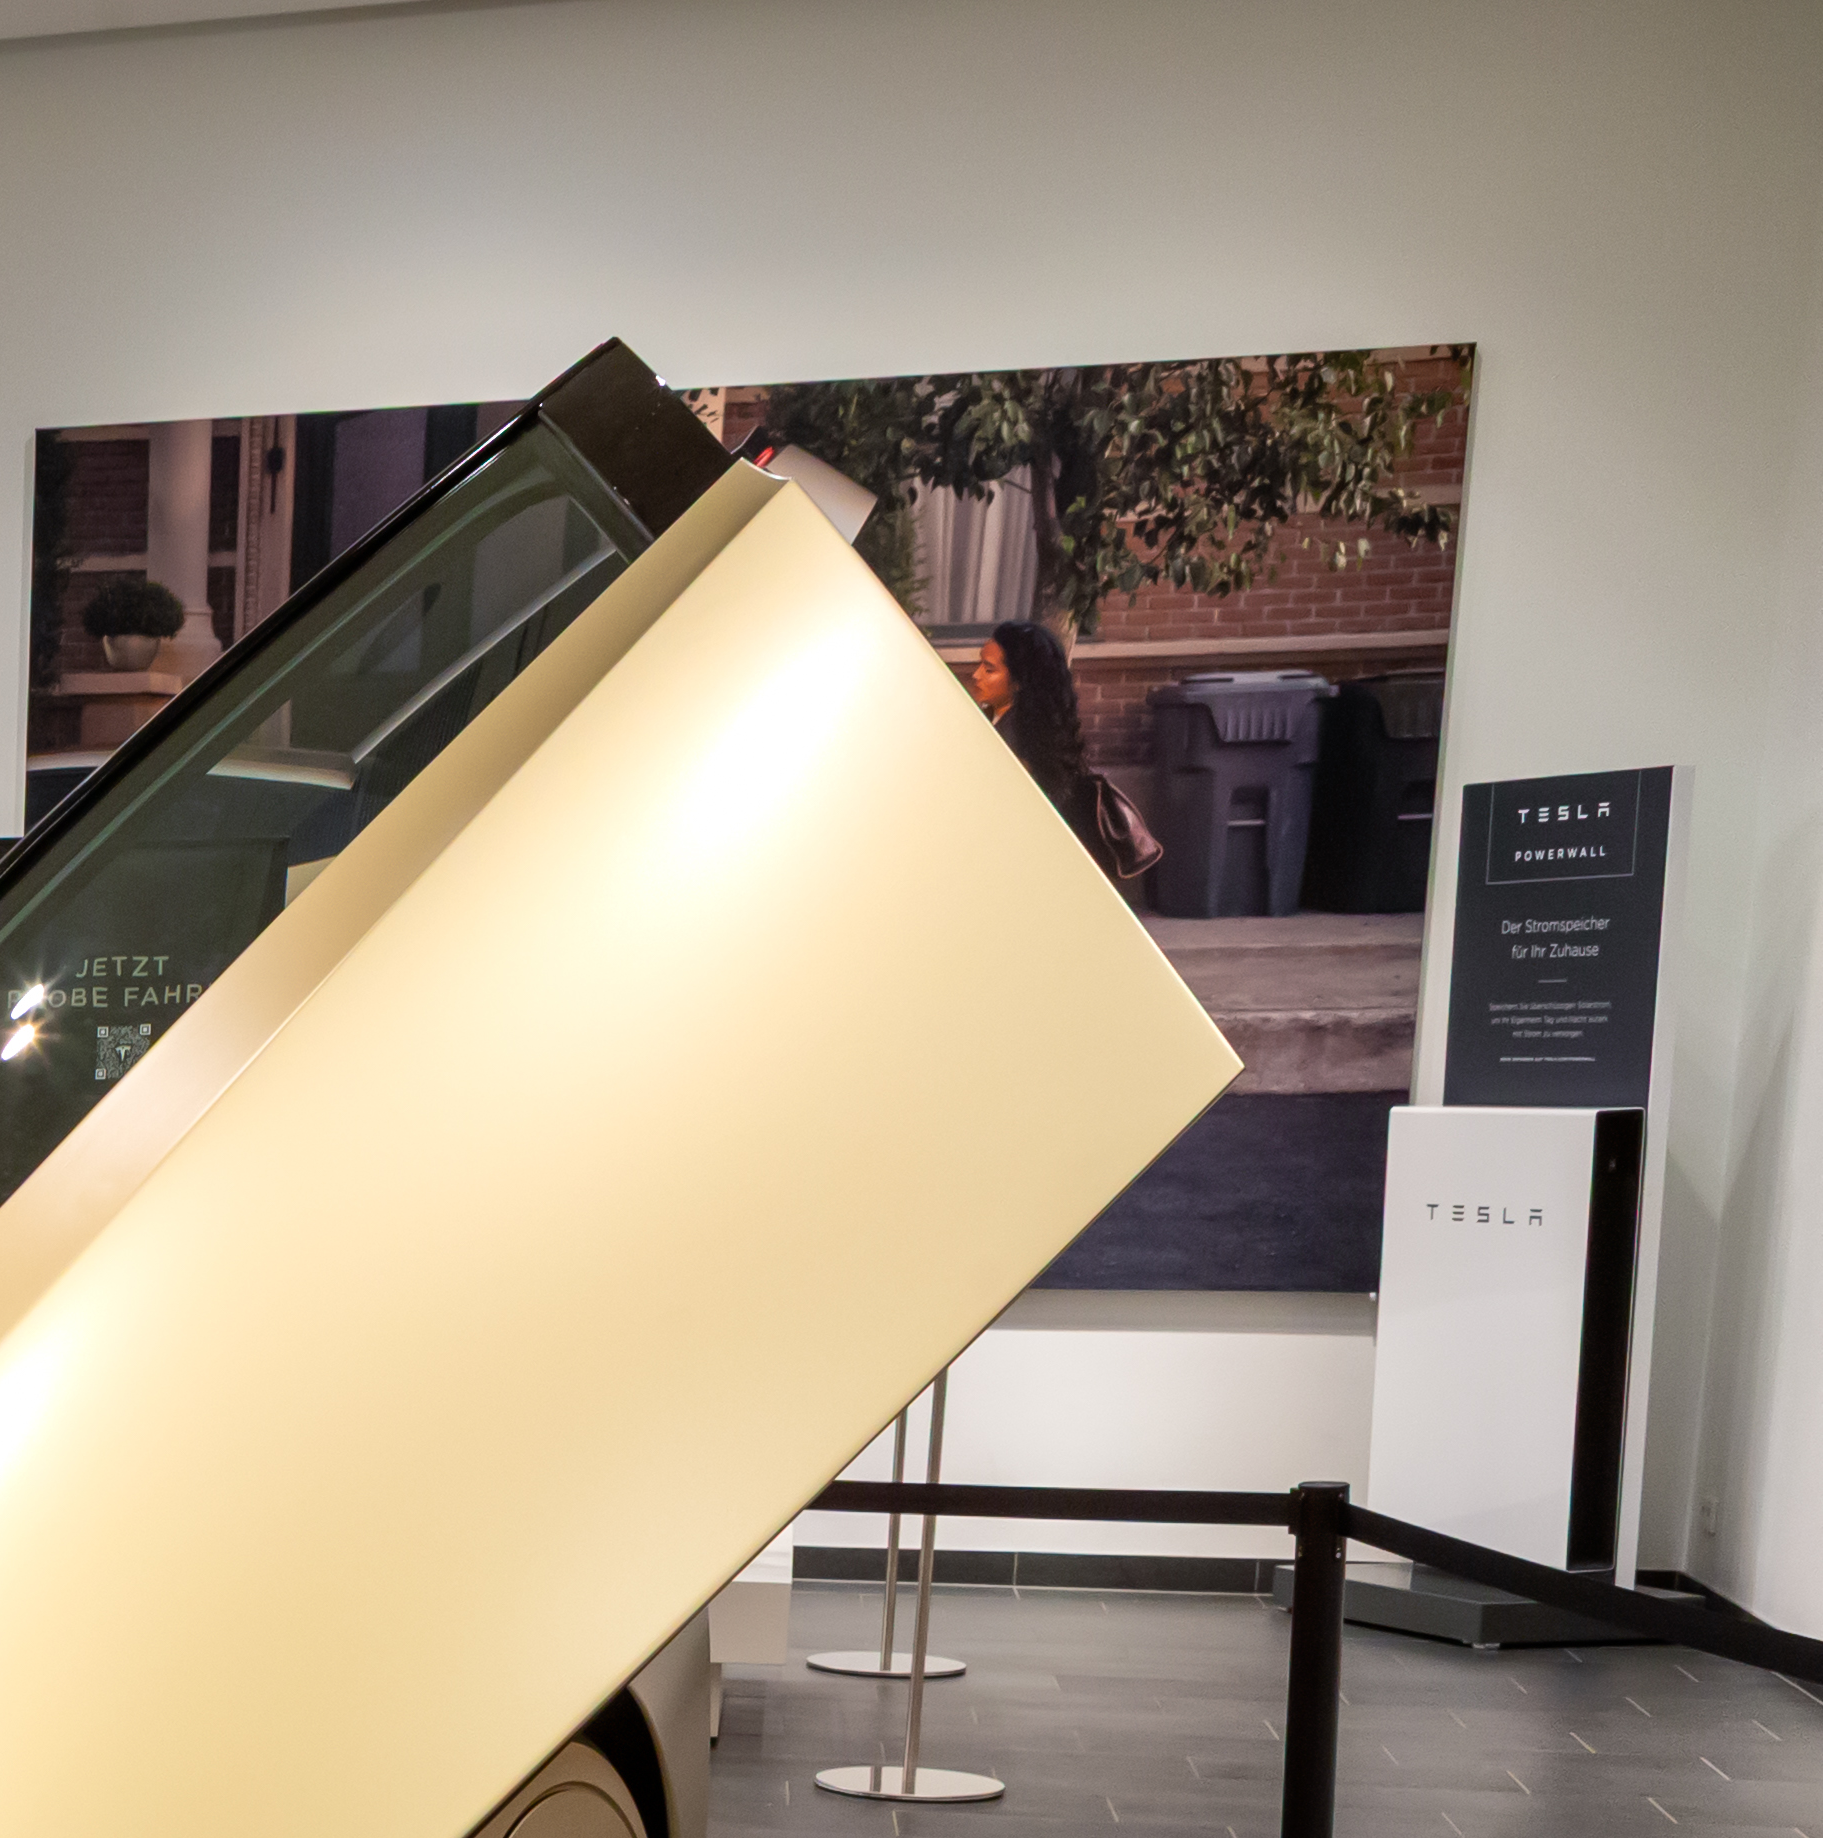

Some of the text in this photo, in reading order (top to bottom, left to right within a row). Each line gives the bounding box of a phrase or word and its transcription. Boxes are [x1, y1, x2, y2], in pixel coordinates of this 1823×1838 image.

[1518, 802, 1611, 824] TESLA
[1515, 846, 1607, 862] POWERWALL
[1501, 916, 1610, 934] Der Stromspeicher
[1511, 943, 1599, 959] für Ihr Zuhause
[75, 956, 169, 978] JETZT
[7, 983, 212, 1008] POBE FAHR
[1426, 1203, 1542, 1226] TESLA
